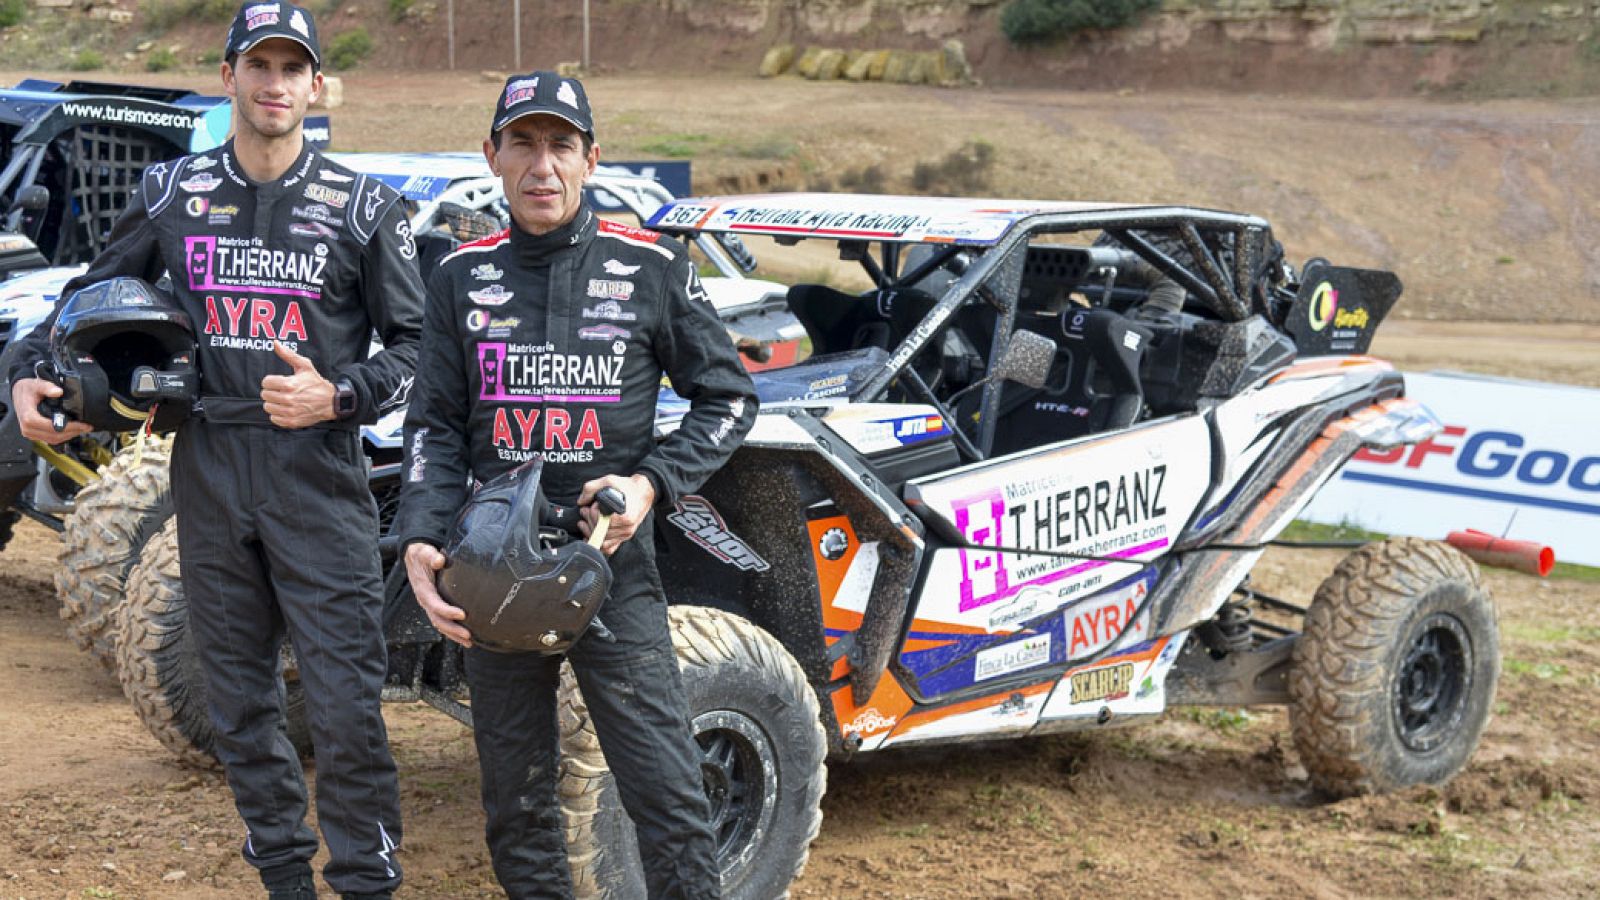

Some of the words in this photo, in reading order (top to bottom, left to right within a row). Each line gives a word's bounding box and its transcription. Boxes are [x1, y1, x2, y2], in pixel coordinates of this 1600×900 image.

[665, 206, 707, 224] 367
[216, 247, 327, 286] T.HERRANZ
[204, 295, 308, 341] AYRA
[506, 353, 625, 386] T.HERRANZ
[492, 407, 604, 450] AYRA
[1008, 463, 1167, 560] T.HERRANZ
[1069, 598, 1142, 656] AYRA
